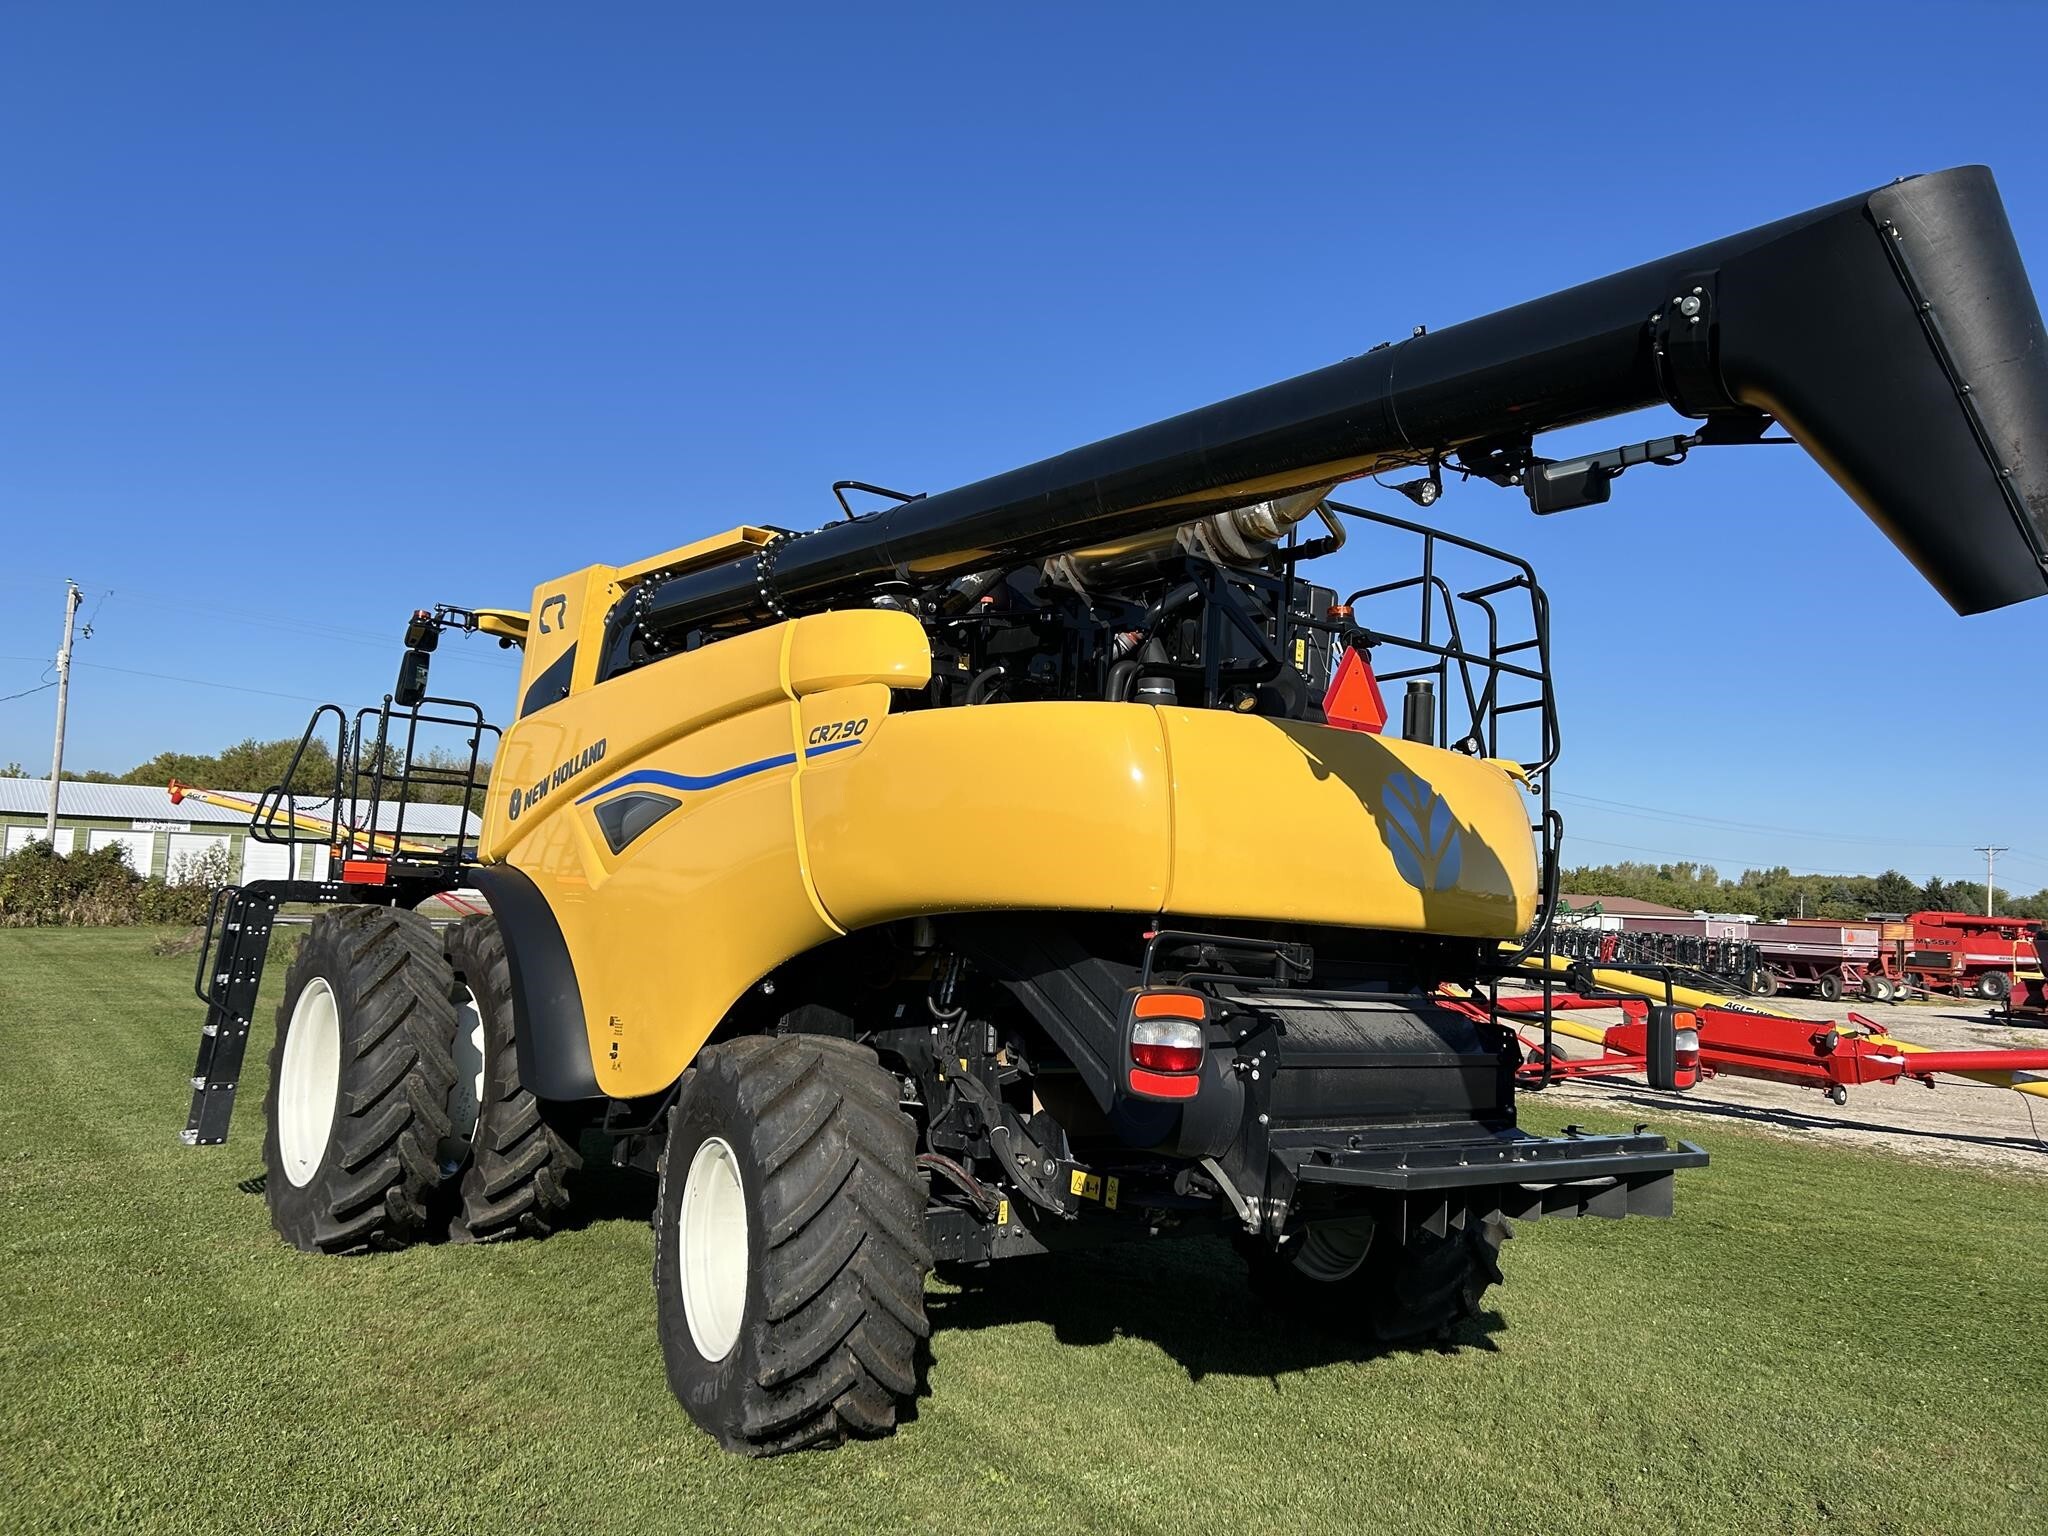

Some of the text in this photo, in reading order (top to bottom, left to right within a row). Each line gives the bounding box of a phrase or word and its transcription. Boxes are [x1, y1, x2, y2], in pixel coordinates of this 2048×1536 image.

[809, 718, 868, 744] CR7.90
[523, 738, 606, 812] NEW HOLLAND
[1724, 1002, 1745, 1012] AGI
